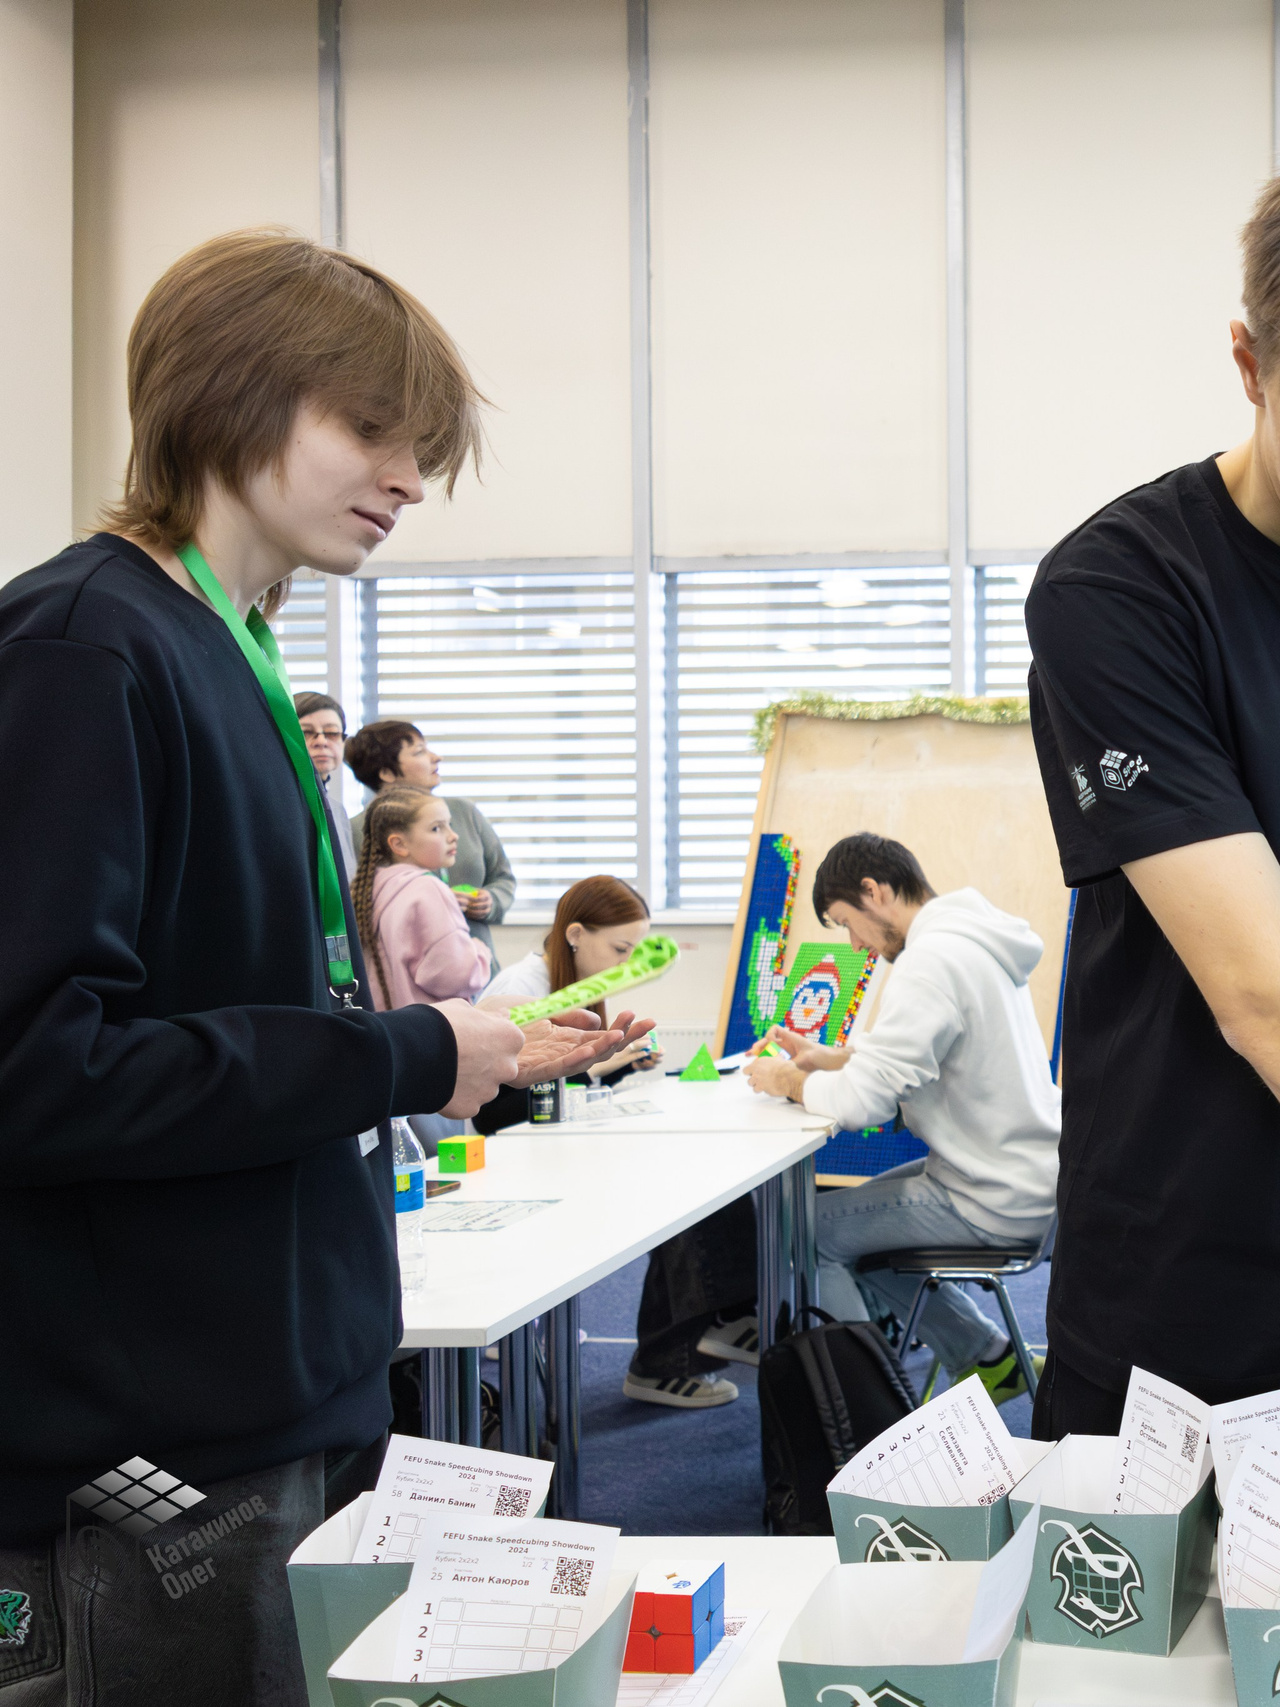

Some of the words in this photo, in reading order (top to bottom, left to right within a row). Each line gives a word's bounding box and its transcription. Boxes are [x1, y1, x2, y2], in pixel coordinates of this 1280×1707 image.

[966, 1396, 978, 1412] FEFU
[975, 1412, 987, 1431] Snake
[916, 1424, 925, 1434] 1
[902, 1433, 911, 1443] 2
[889, 1442, 898, 1452] 3
[945, 1425, 968, 1466] Елизавета
[1126, 1439, 1131, 1450] 1
[878, 1453, 885, 1461] 4
[939, 1430, 964, 1476] Селиванова
[984, 1446, 996, 1461] 2024
[866, 1461, 874, 1470] 5
[1122, 1456, 1129, 1467] 2
[403, 1455, 423, 1463] FEFU
[424, 1458, 446, 1467] Snake
[448, 1462, 494, 1476] Speedcubing
[495, 1470, 533, 1482] Showdown
[458, 1472, 476, 1480] 2024
[1119, 1474, 1125, 1485] 3
[409, 1492, 445, 1504] Даниил
[448, 1498, 476, 1508] Банин
[1116, 1492, 1121, 1502] 4
[1248, 1505, 1265, 1519] Кира
[383, 1515, 391, 1527] 1
[376, 1535, 386, 1546] 2
[443, 1532, 465, 1540] FEFU
[467, 1534, 493, 1542] Snake
[496, 1536, 550, 1547] Speedcubing
[552, 1540, 595, 1552] Showdown
[508, 1546, 529, 1554] 2024
[452, 1573, 485, 1583] Антон
[488, 1576, 530, 1587] Каюров
[423, 1602, 433, 1615] 1
[417, 1626, 428, 1639] 2
[413, 1649, 424, 1662] 3
